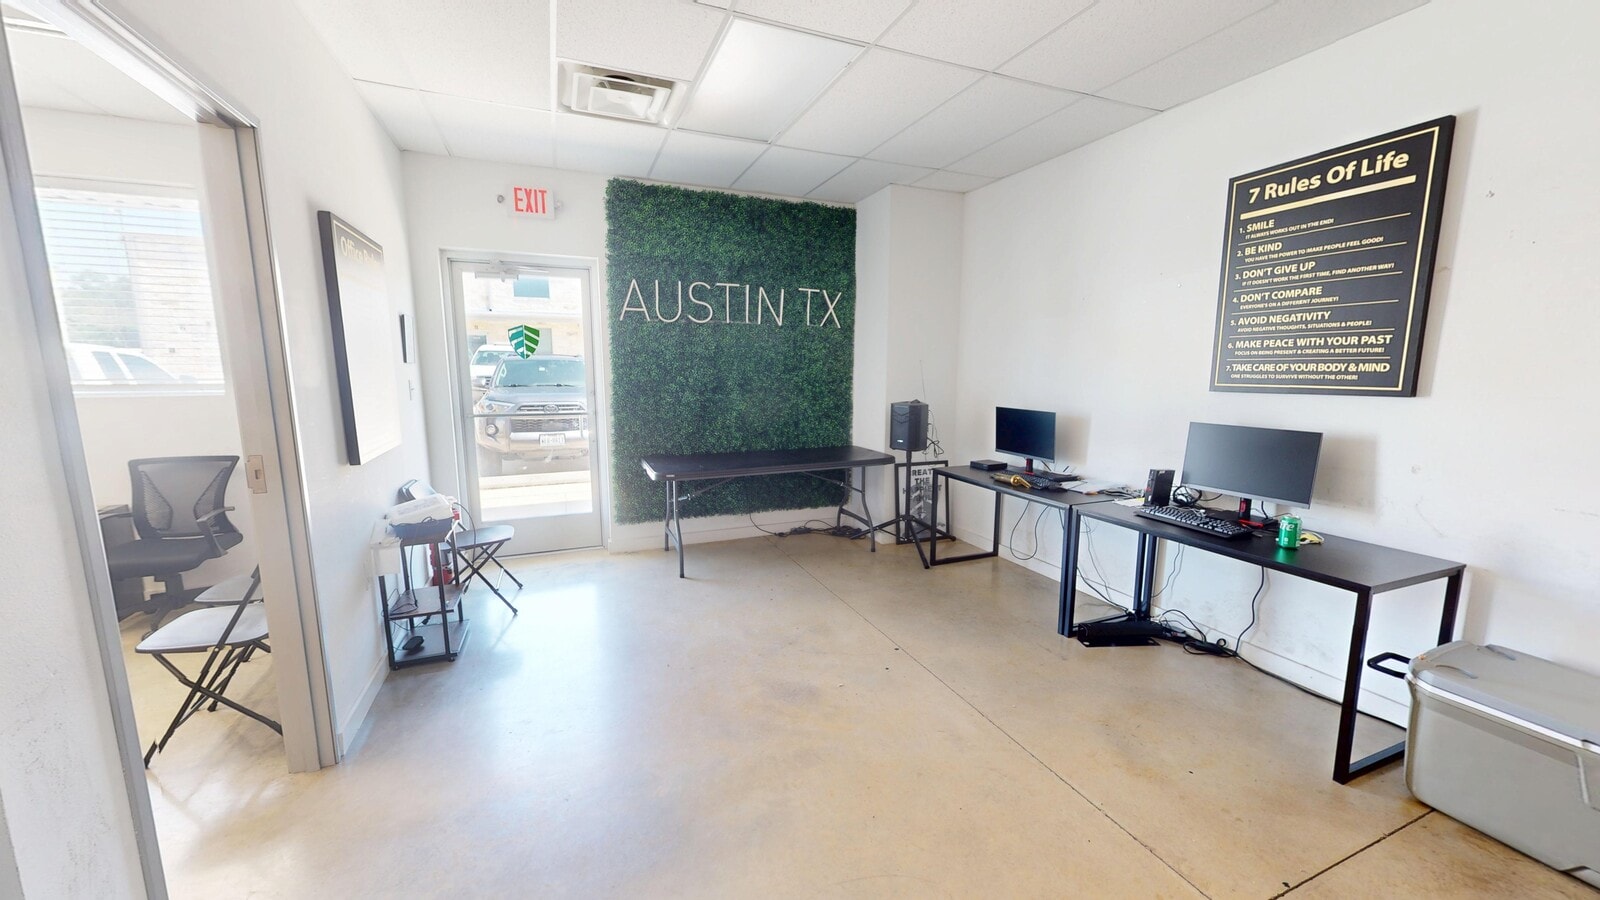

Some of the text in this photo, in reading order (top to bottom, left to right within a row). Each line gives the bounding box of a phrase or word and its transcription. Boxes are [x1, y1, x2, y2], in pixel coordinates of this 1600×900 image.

[1249, 150, 1409, 204] 7 Rules Of Life
[514, 187, 547, 214] EXIT
[1246, 219, 1275, 232] SMILE
[1250, 231, 1269, 239] ALWAYS
[1270, 227, 1288, 236] WORKS
[1320, 218, 1335, 226] END!
[1244, 246, 1256, 256] BE
[1257, 242, 1282, 254] KIND
[1279, 250, 1297, 258] POWER
[1306, 245, 1323, 253] MAKE
[1324, 242, 1346, 251] PEOPLE
[1346, 239, 1361, 247] FEEL
[1361, 236, 1384, 245] GOOD!
[1242, 267, 1273, 279] DON'T
[1274, 264, 1298, 275] GIVE
[1299, 261, 1316, 271] UP
[1347, 265, 1376, 274] ANOTHER
[1377, 262, 1395, 270] WAY!
[1240, 291, 1271, 303] DON'T
[1271, 286, 1323, 300] COMPARE
[1282, 298, 1310, 306] DIFFERENT
[1311, 296, 1339, 304] JOURNEY!
[620, 278, 842, 329] AUSTIN TX
[1238, 315, 1268, 326] AVOID
[1268, 311, 1331, 323] NEGATIVITY
[1235, 340, 1262, 349] MAKE
[1263, 339, 1294, 348] PEACE
[1296, 337, 1324, 346] WITH
[1326, 336, 1359, 346] YOUR
[1361, 334, 1393, 345] PAST
[1231, 363, 1253, 372] TAKE
[1252, 363, 1276, 372] CARE
[1275, 363, 1289, 372] OF
[1289, 363, 1317, 372] YOUR
[1317, 363, 1348, 372] BODY
[1348, 363, 1357, 372] &
[1357, 363, 1391, 372] MIND
[915, 477, 930, 486] THE
